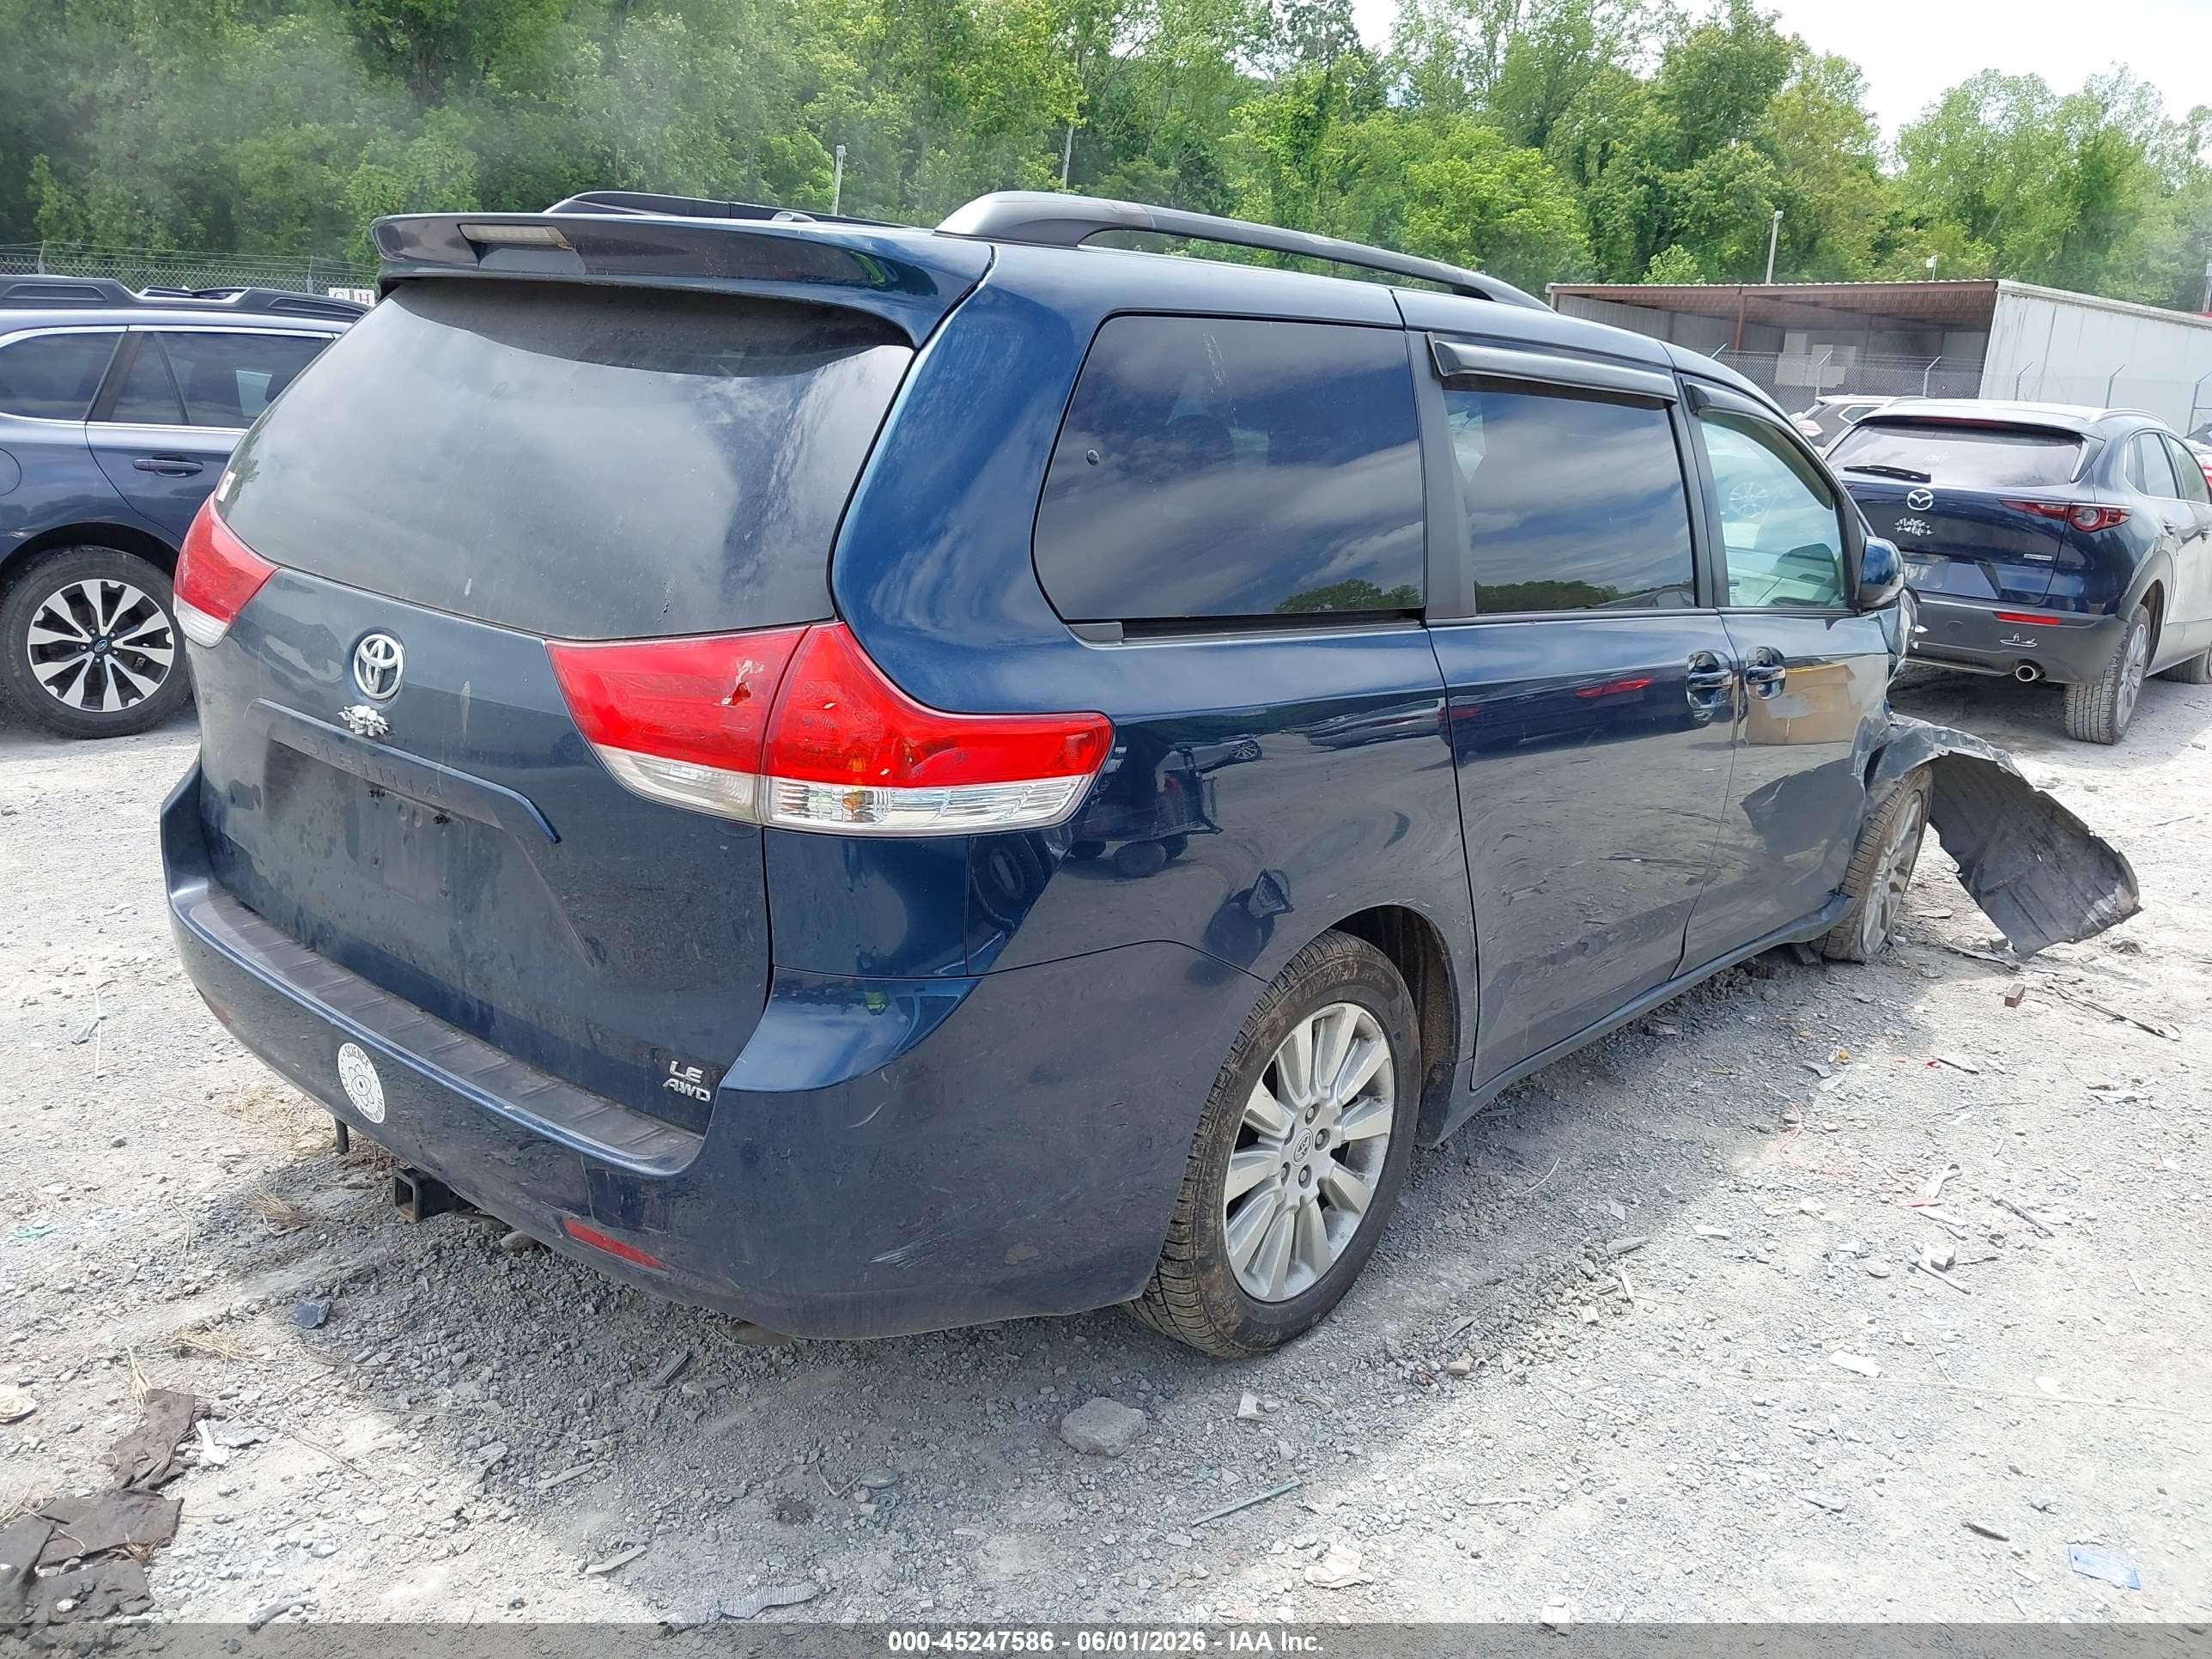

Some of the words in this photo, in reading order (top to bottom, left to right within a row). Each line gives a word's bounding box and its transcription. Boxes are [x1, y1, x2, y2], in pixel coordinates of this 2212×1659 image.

[344, 1044, 371, 1070] SCIENCE
[670, 1060, 704, 1084] LE
[662, 1078, 711, 1102] AWD
